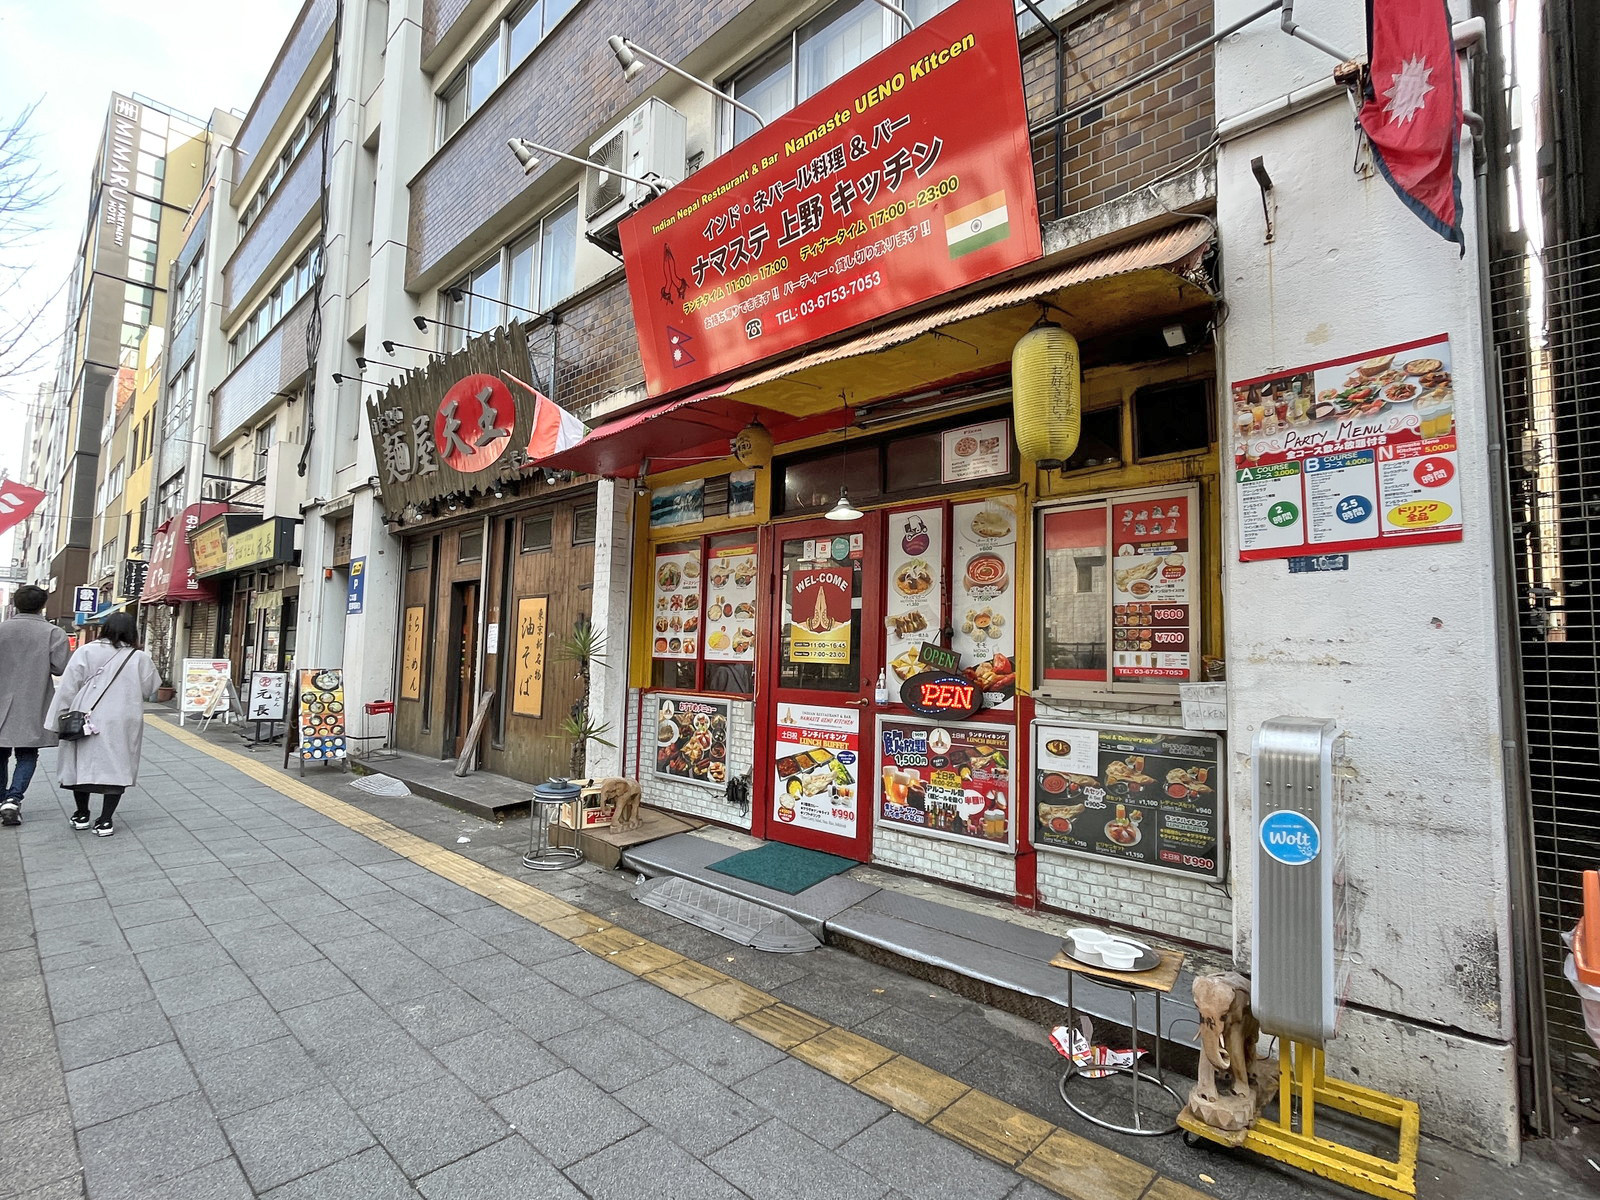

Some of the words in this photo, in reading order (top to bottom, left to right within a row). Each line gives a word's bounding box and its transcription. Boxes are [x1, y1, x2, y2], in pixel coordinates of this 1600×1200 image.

[651, 216, 676, 236] Indian
[676, 198, 700, 220] Nepal
[701, 169, 750, 205] Restaurant
[751, 163, 760, 176] &
[761, 152, 779, 171] Bar
[784, 109, 851, 157] Namaste
[854, 72, 905, 115] UENO
[910, 32, 976, 82] Kitcen
[108, 119, 133, 204] MIMARU
[702, 143, 847, 241] インド・ネパール料理
[850, 136, 870, 160] &
[871, 113, 911, 149] バー
[106, 200, 117, 226] HOTEL
[691, 222, 770, 288] ナマステ
[777, 193, 824, 248] 上野
[830, 136, 944, 217] キッチン
[114, 203, 127, 248] APARTMENT
[726, 274, 752, 296] 11:00
[759, 256, 788, 280] 17:00
[800, 220, 867, 262] ディナータイム
[869, 200, 906, 230] 17:00
[917, 175, 960, 208] 23:00
[775, 306, 799, 326] TEL:
[799, 271, 882, 316] 03-6753-7053
[1284, 430, 1328, 449] PARTY
[1337, 420, 1384, 441] MENU
[382, 414, 439, 485] 麺屋
[1286, 435, 1387, 460] 全コース飲み放題付き
[1379, 444, 1394, 461] N
[1305, 457, 1320, 472] B
[1323, 452, 1358, 463] COURSE
[1424, 462, 1435, 472] 3
[1240, 467, 1254, 482] A
[1257, 463, 1289, 473] COURSE
[1255, 472, 1272, 480] コース
[1421, 469, 1448, 484] 時間
[1275, 505, 1284, 514] 2
[1340, 498, 1359, 511] 2.5
[1397, 503, 1439, 516] ドリンク
[1272, 511, 1294, 525] 時間
[1341, 506, 1366, 521] 時間
[1406, 512, 1430, 523] 全品
[795, 572, 849, 594] WEL-COME
[1155, 609, 1184, 619] ¥600
[1155, 632, 1184, 643] ¥700
[409, 616, 420, 691] らーめん
[519, 616, 535, 697] 油そば
[923, 645, 956, 669] OPEN
[254, 689, 272, 717] 元長
[782, 731, 798, 740] 土日祝
[802, 729, 848, 742] ランチバイキング
[968, 732, 1006, 740] ランチバイキング
[895, 755, 928, 765] 1,500円
[935, 772, 955, 781] 土日祝
[926, 785, 965, 797] アルコール類
[832, 808, 855, 821] ¥990
[1269, 831, 1310, 846] Wolt
[1184, 855, 1214, 870] ¥990
